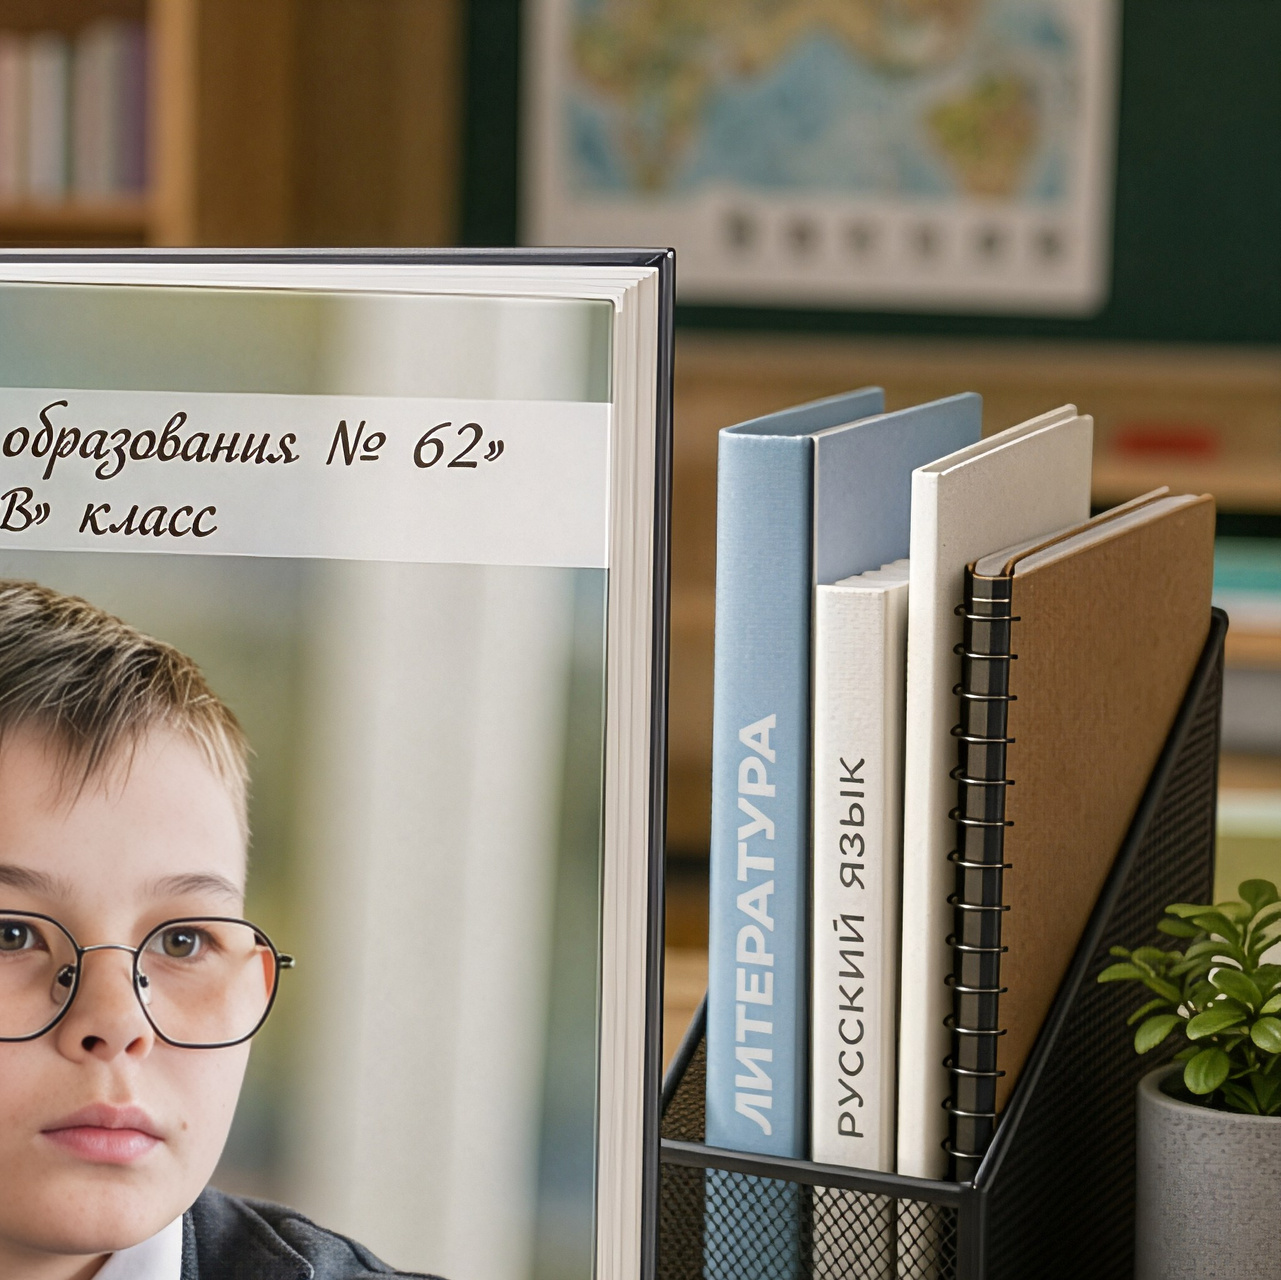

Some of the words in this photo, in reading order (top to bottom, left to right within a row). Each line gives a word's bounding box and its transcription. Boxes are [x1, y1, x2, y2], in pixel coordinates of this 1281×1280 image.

[2, 400, 300, 481] образования
[325, 420, 387, 466] №
[413, 422, 505, 469] 62»
[78, 502, 219, 538] класс
[839, 757, 865, 890] ЯЗЫК
[734, 713, 777, 1136] ЛИТЕРАТУРА
[832, 913, 865, 1138] РУССКИЙ
